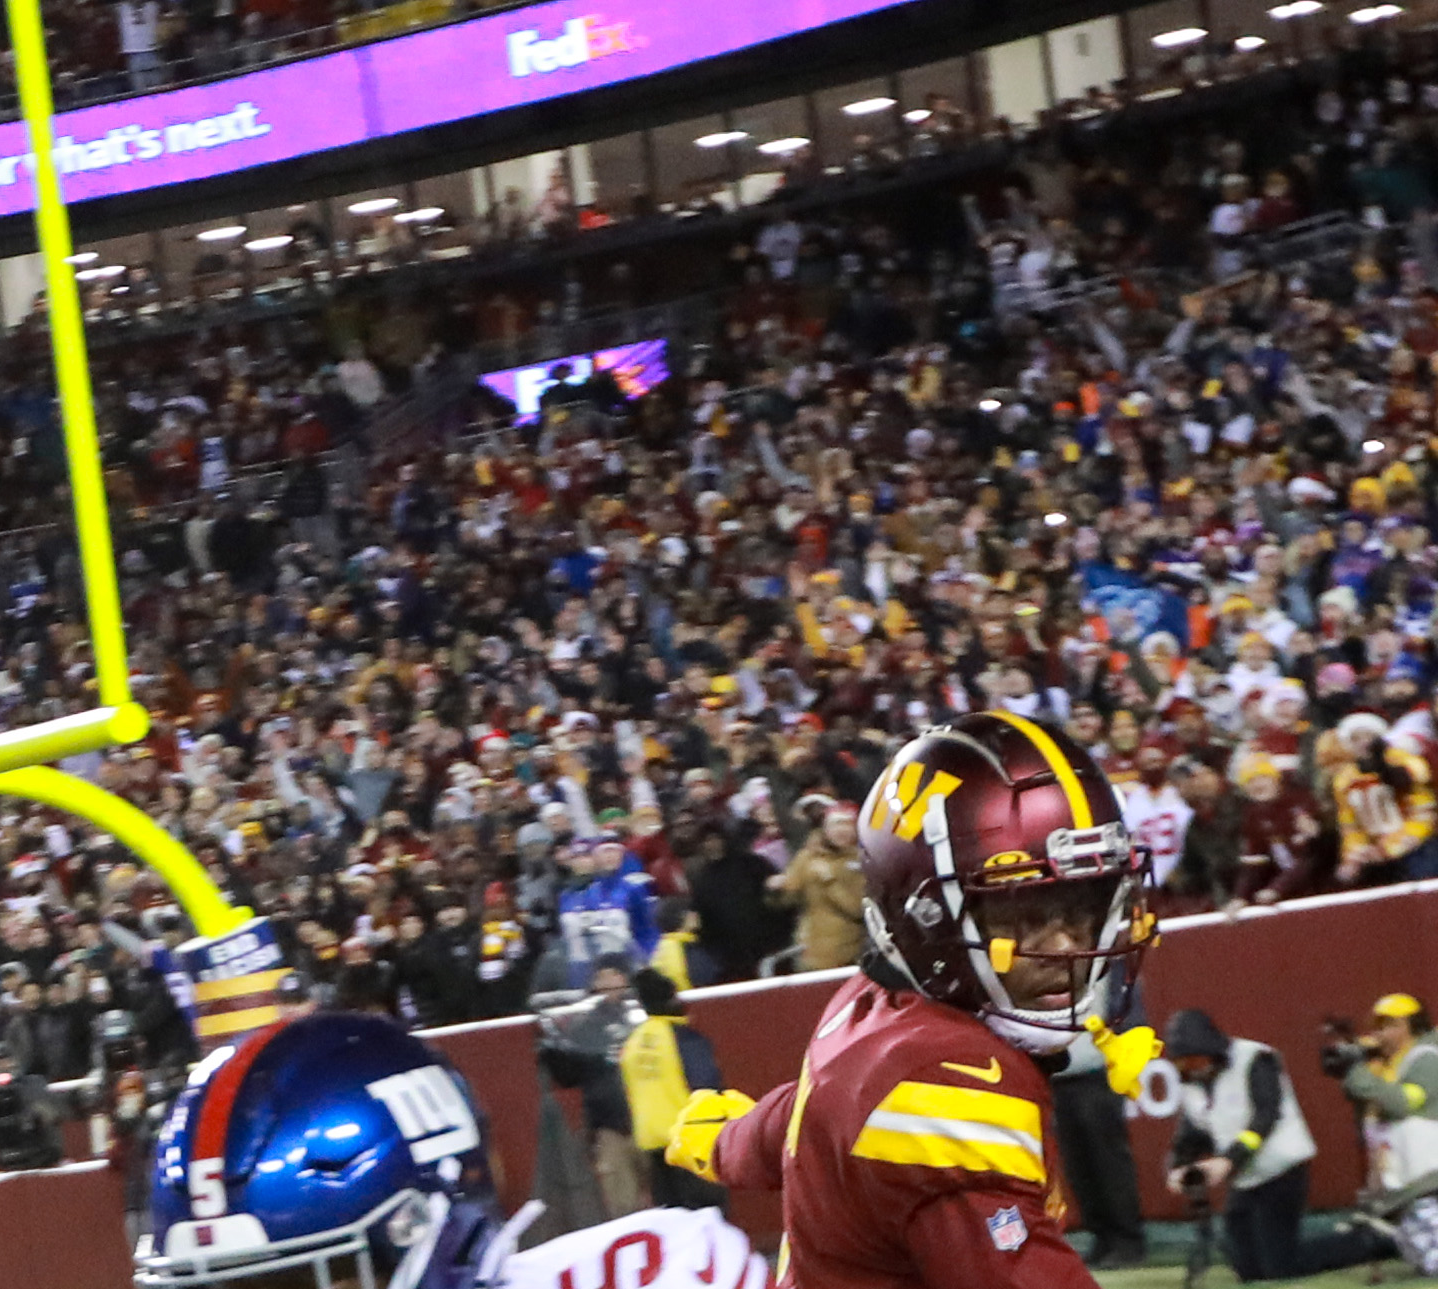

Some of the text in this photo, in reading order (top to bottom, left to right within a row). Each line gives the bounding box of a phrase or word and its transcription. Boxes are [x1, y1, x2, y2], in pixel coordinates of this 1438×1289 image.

[506, 14, 634, 77] FedEx
[21, 125, 161, 174] hat's
[165, 102, 271, 153] next.
[188, 1156, 228, 1218] 5
